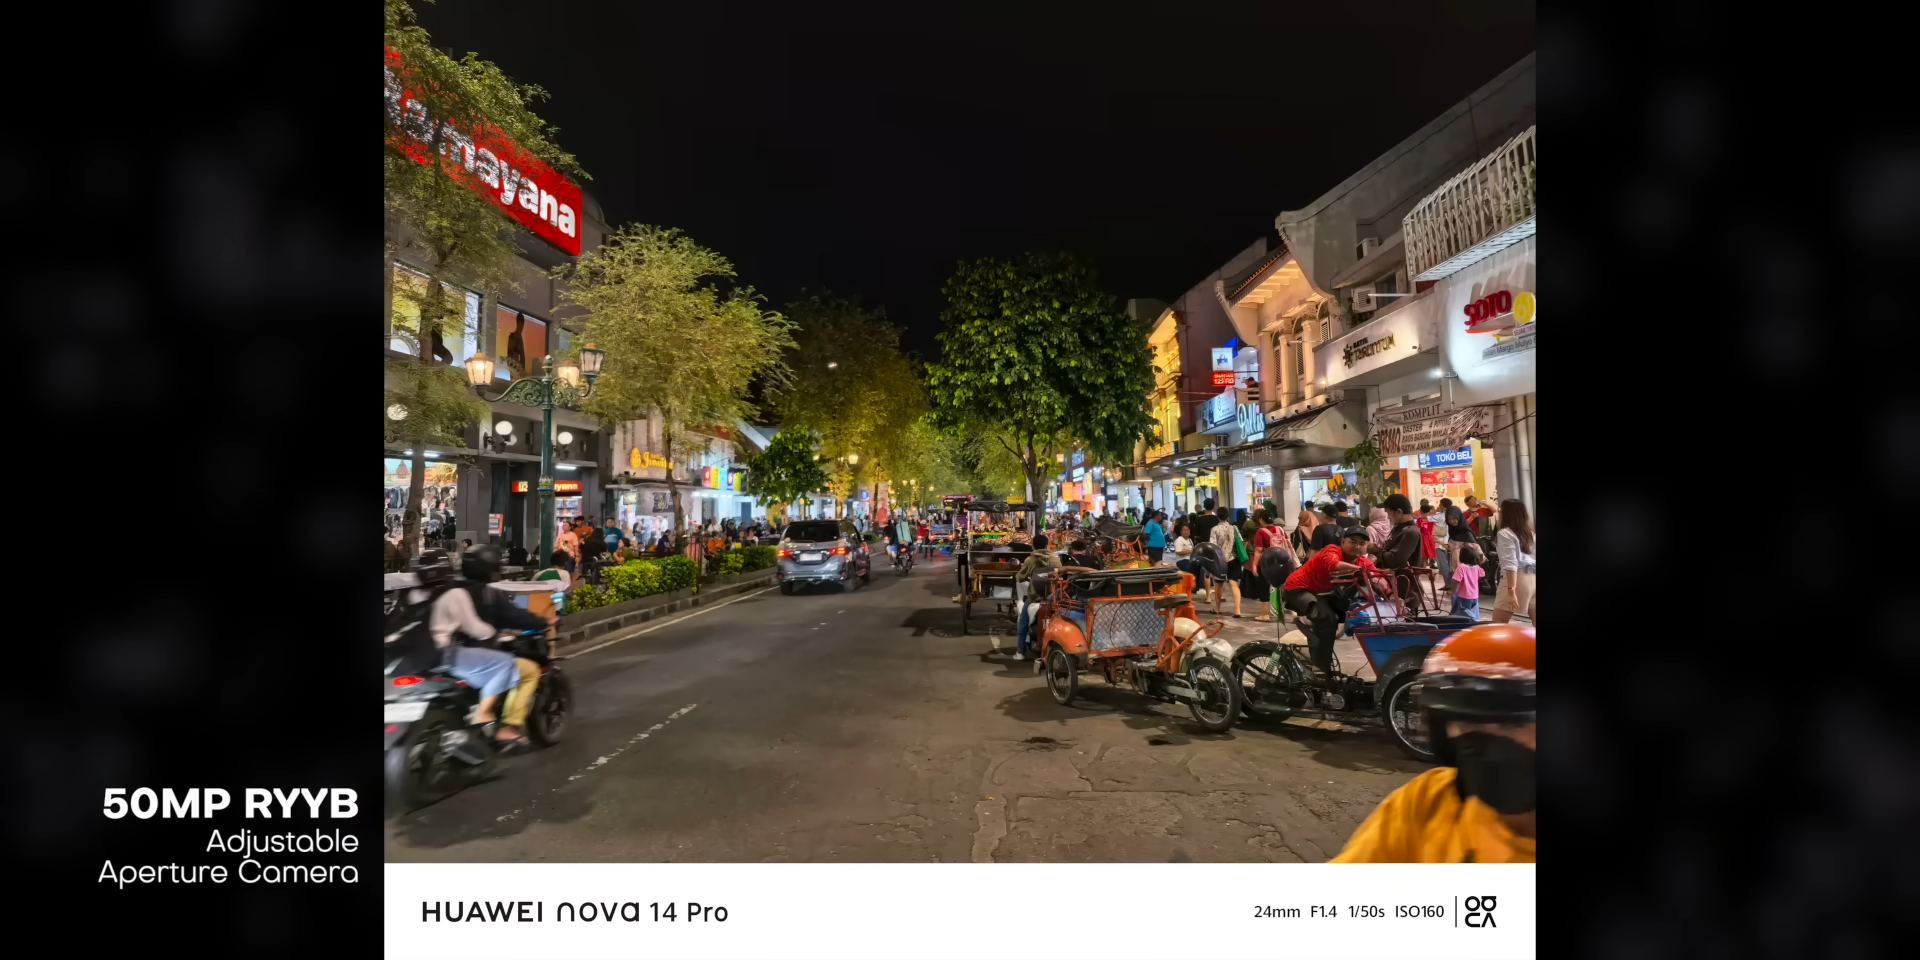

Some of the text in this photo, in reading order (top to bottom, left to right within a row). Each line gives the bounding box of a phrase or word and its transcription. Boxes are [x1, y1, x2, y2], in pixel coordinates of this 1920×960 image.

[1463, 290, 1512, 326] SOTO
[1353, 337, 1369, 348] BATIK
[1497, 343, 1514, 353] Margo
[1515, 338, 1533, 349] Mulyo
[1402, 404, 1441, 421] KOMPLIT
[1402, 423, 1423, 434] DASTER
[1402, 434, 1414, 444] KAOS
[1414, 431, 1431, 442] BARONG
[1416, 441, 1431, 451] ANAK
[1436, 452, 1456, 463] TOKO
